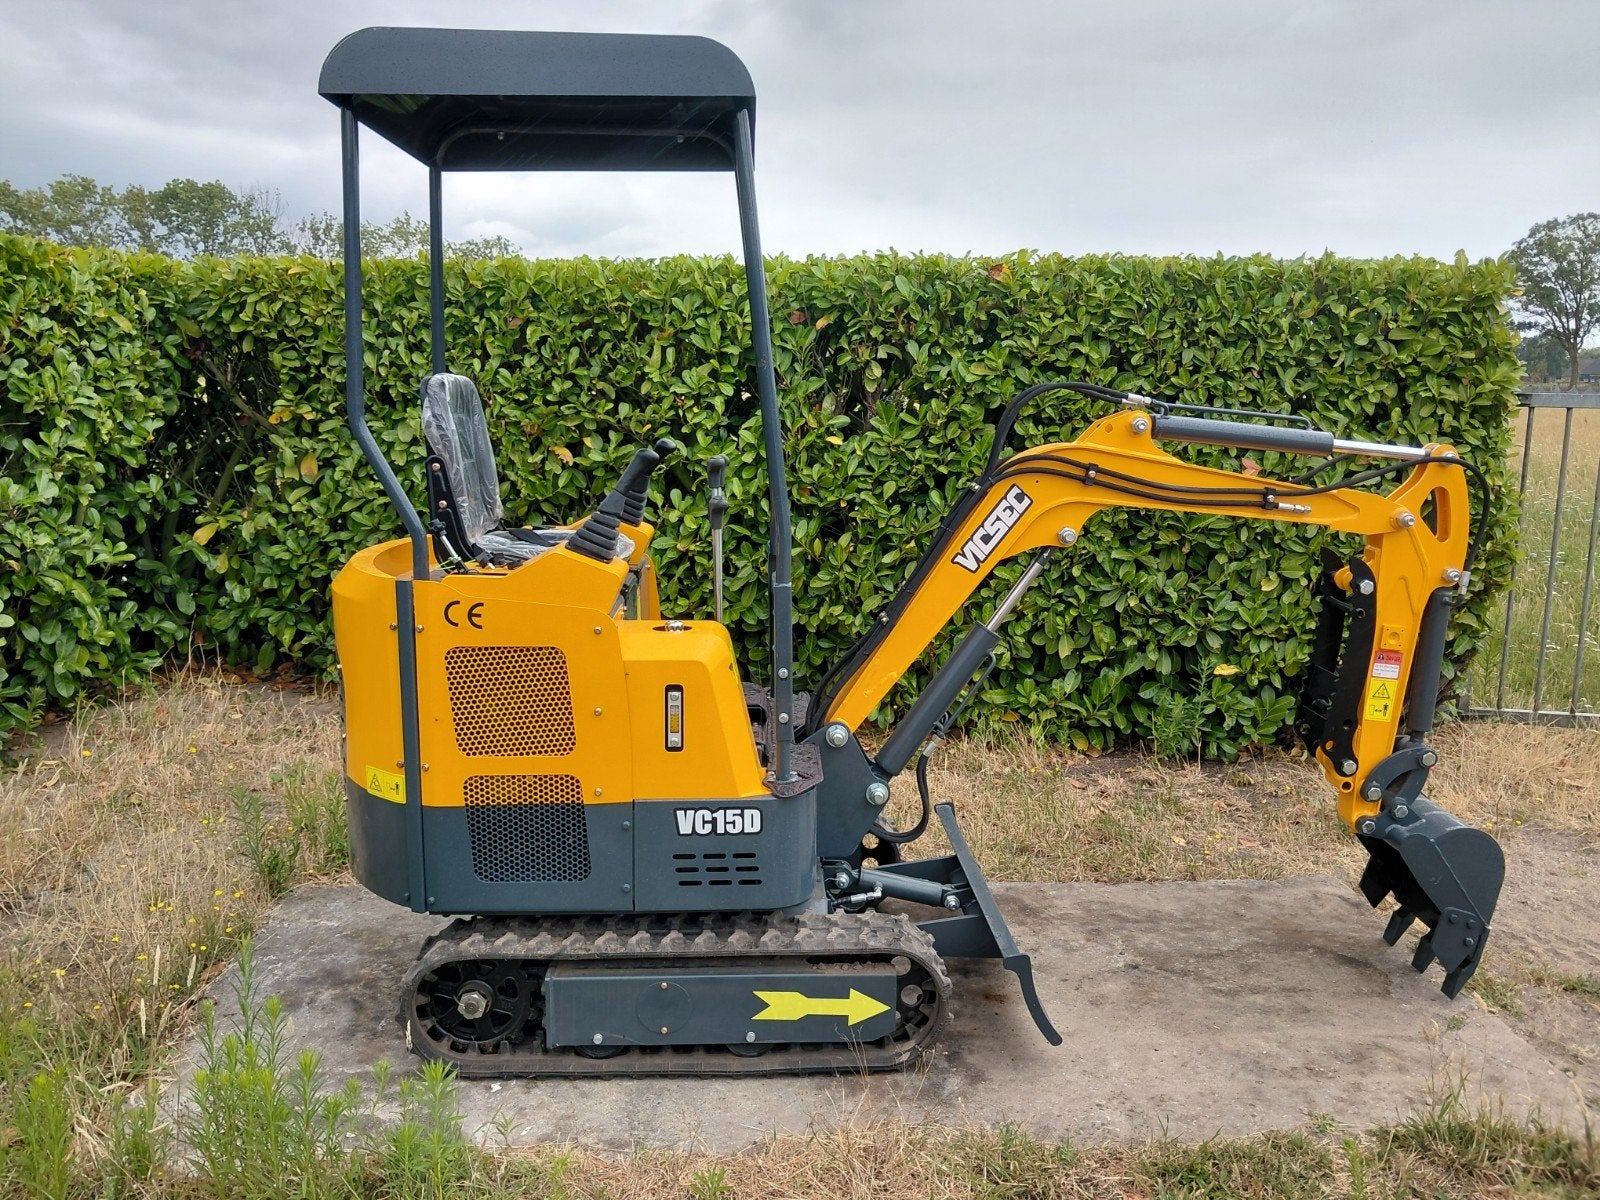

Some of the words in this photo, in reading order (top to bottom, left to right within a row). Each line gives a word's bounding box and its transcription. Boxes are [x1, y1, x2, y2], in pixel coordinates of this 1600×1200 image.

[952, 484, 1032, 572] VICSEC
[443, 600, 485, 630] CE
[675, 808, 762, 835] VC15D
